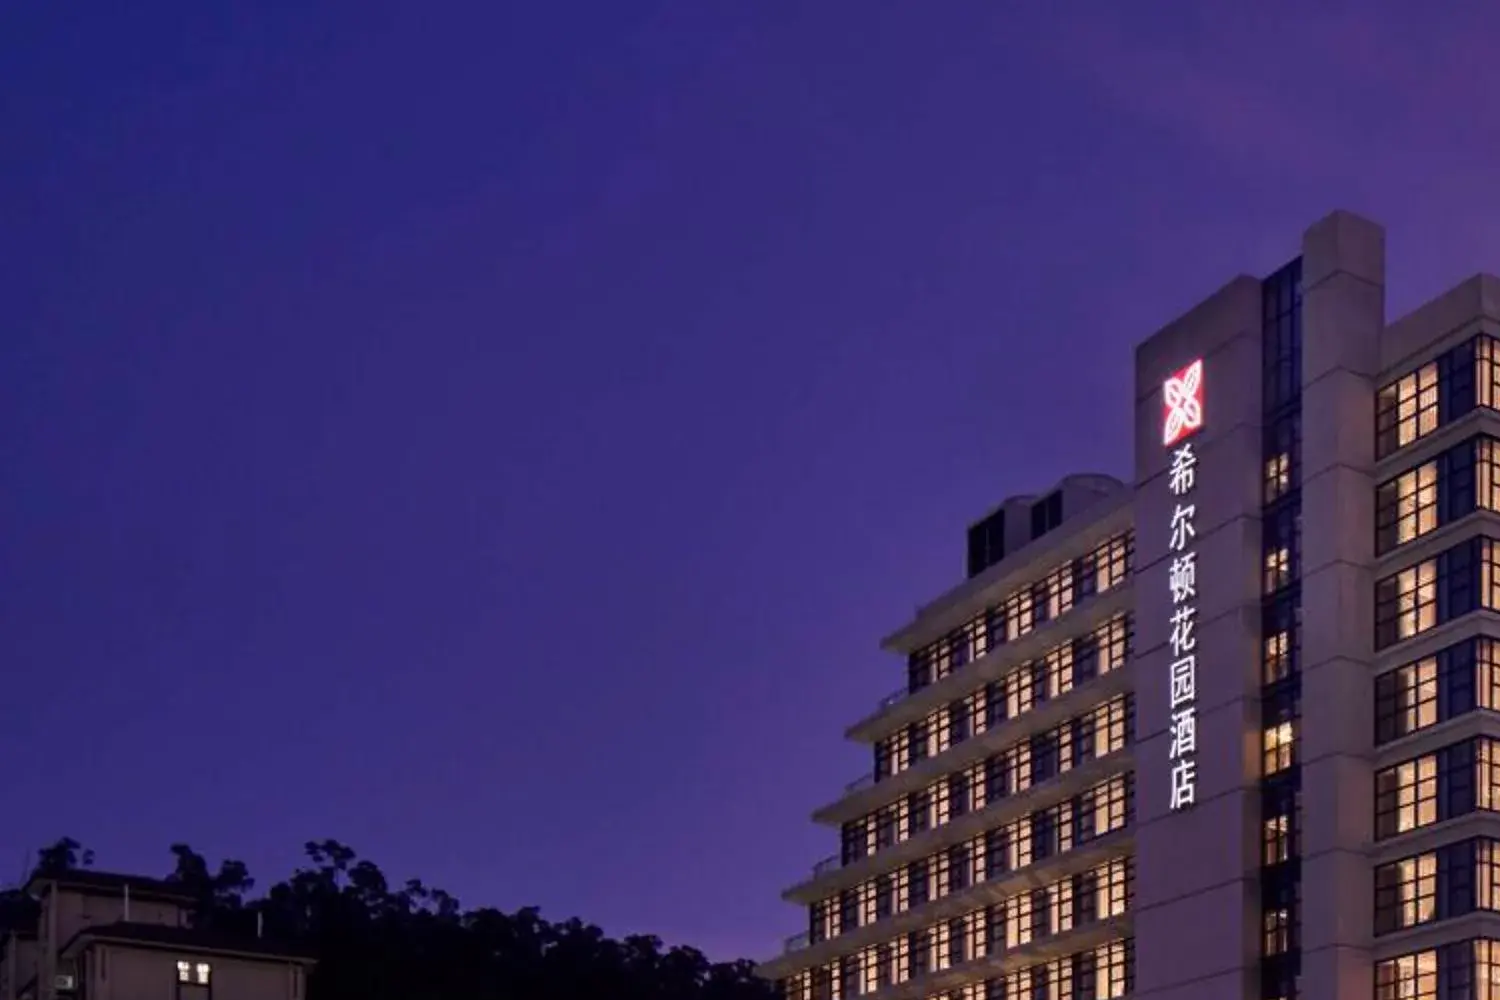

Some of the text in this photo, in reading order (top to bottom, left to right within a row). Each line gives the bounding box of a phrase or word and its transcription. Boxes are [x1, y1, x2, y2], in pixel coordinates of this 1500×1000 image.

[1169, 444, 1196, 809] 希尔顿花园酒店
